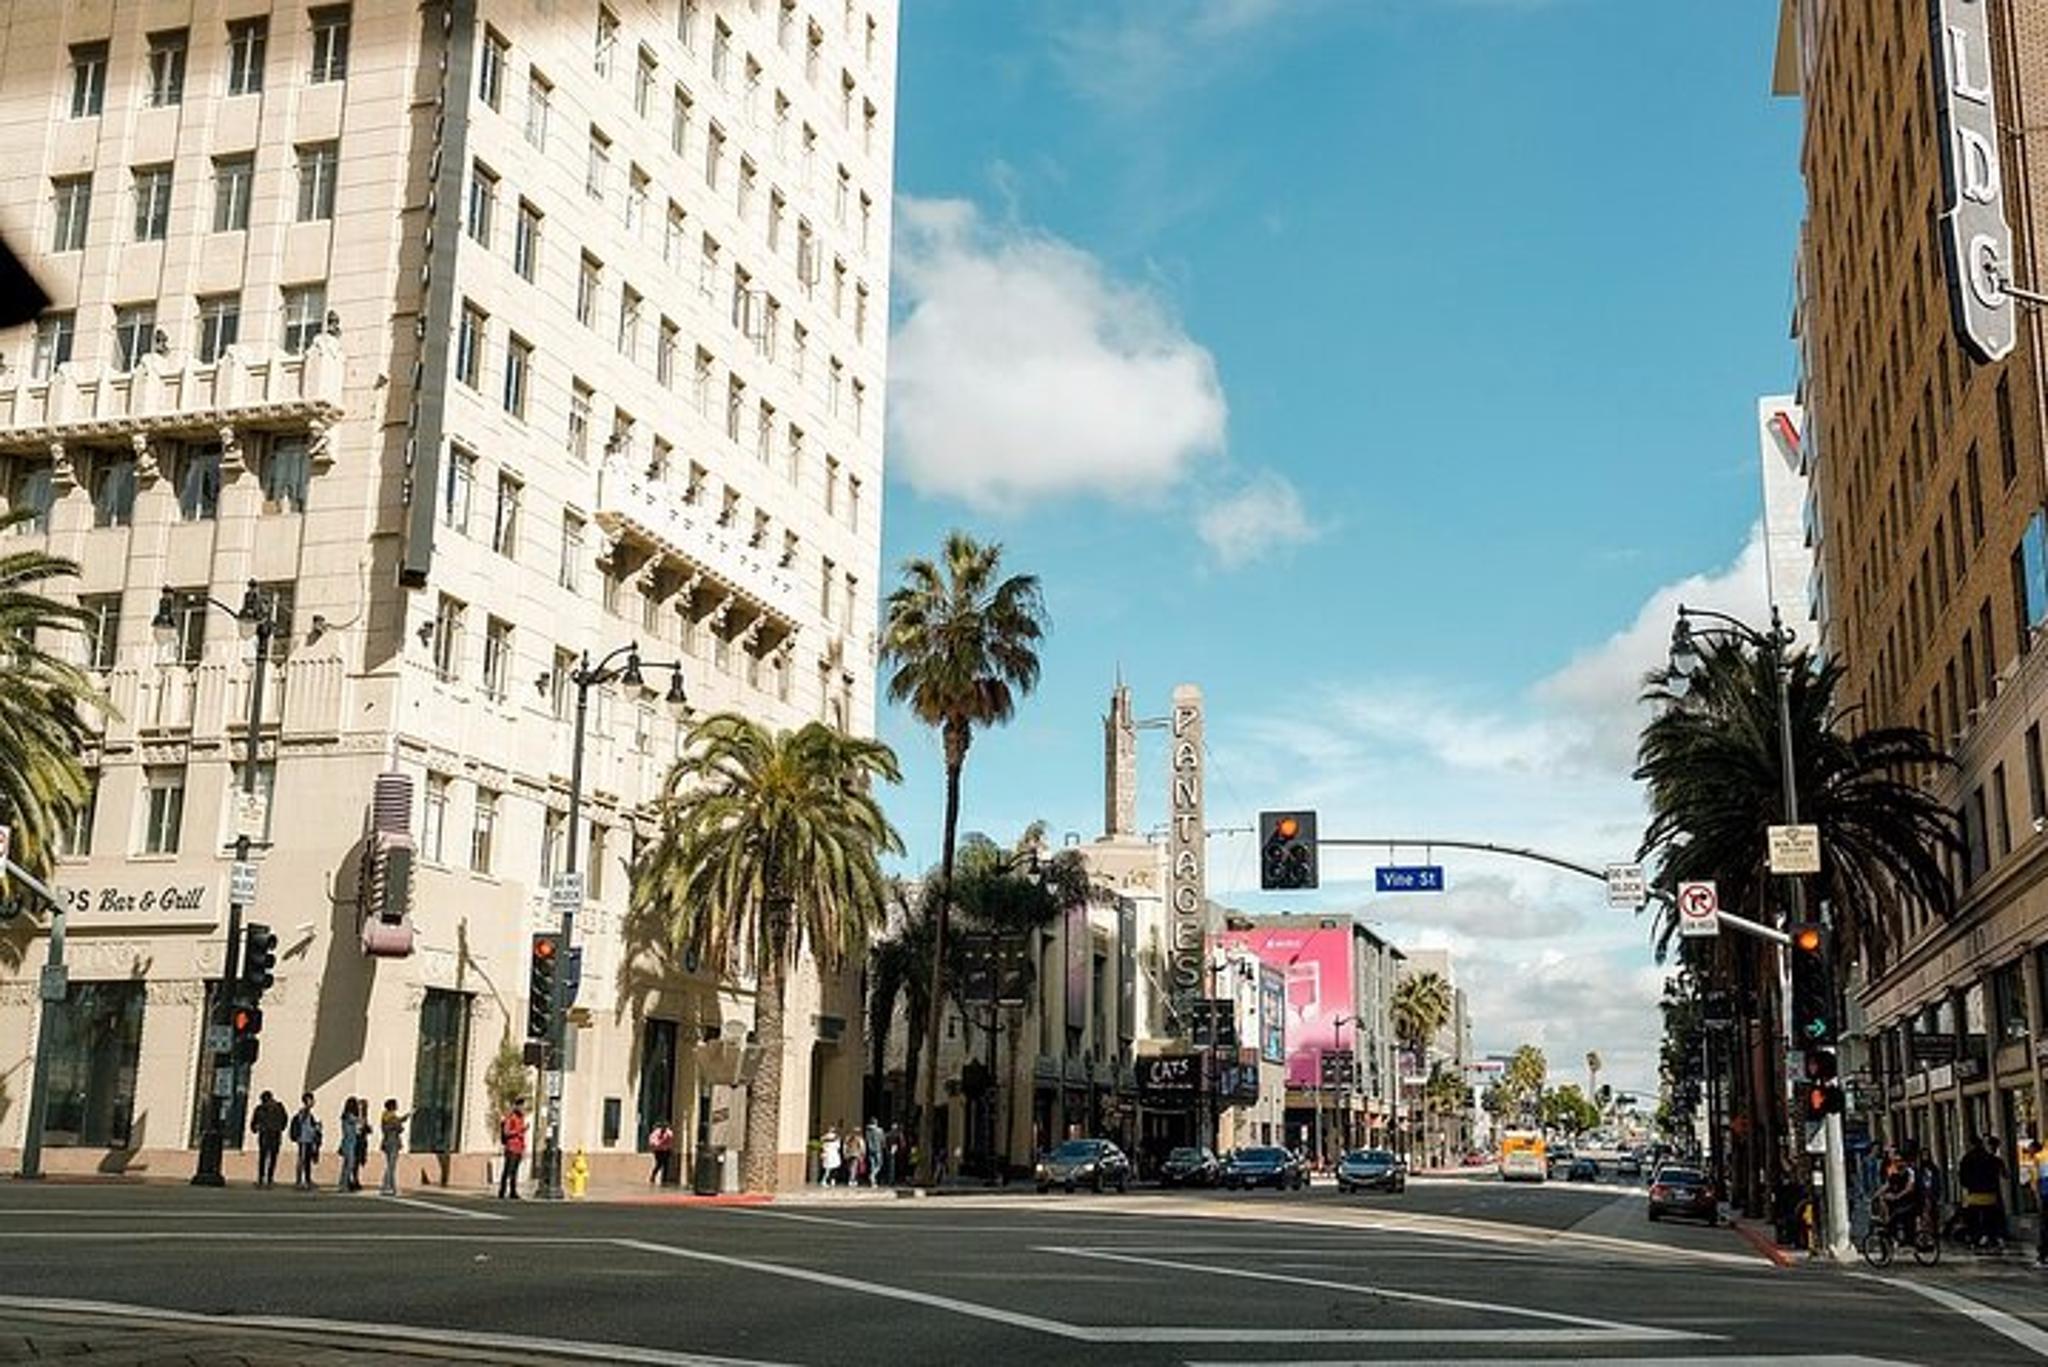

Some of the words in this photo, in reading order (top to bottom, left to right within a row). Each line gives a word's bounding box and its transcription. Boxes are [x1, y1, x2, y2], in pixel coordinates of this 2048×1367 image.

[1173, 705, 1199, 988] PANTAGES
[1384, 873, 1414, 886] Vine
[1418, 871, 1437, 886] St
[1611, 882, 1641, 892] BLOCK
[99, 888, 136, 912] Bar
[139, 889, 156, 912] &
[159, 885, 205, 912] Grill
[1150, 1059, 1189, 1083] CATS
